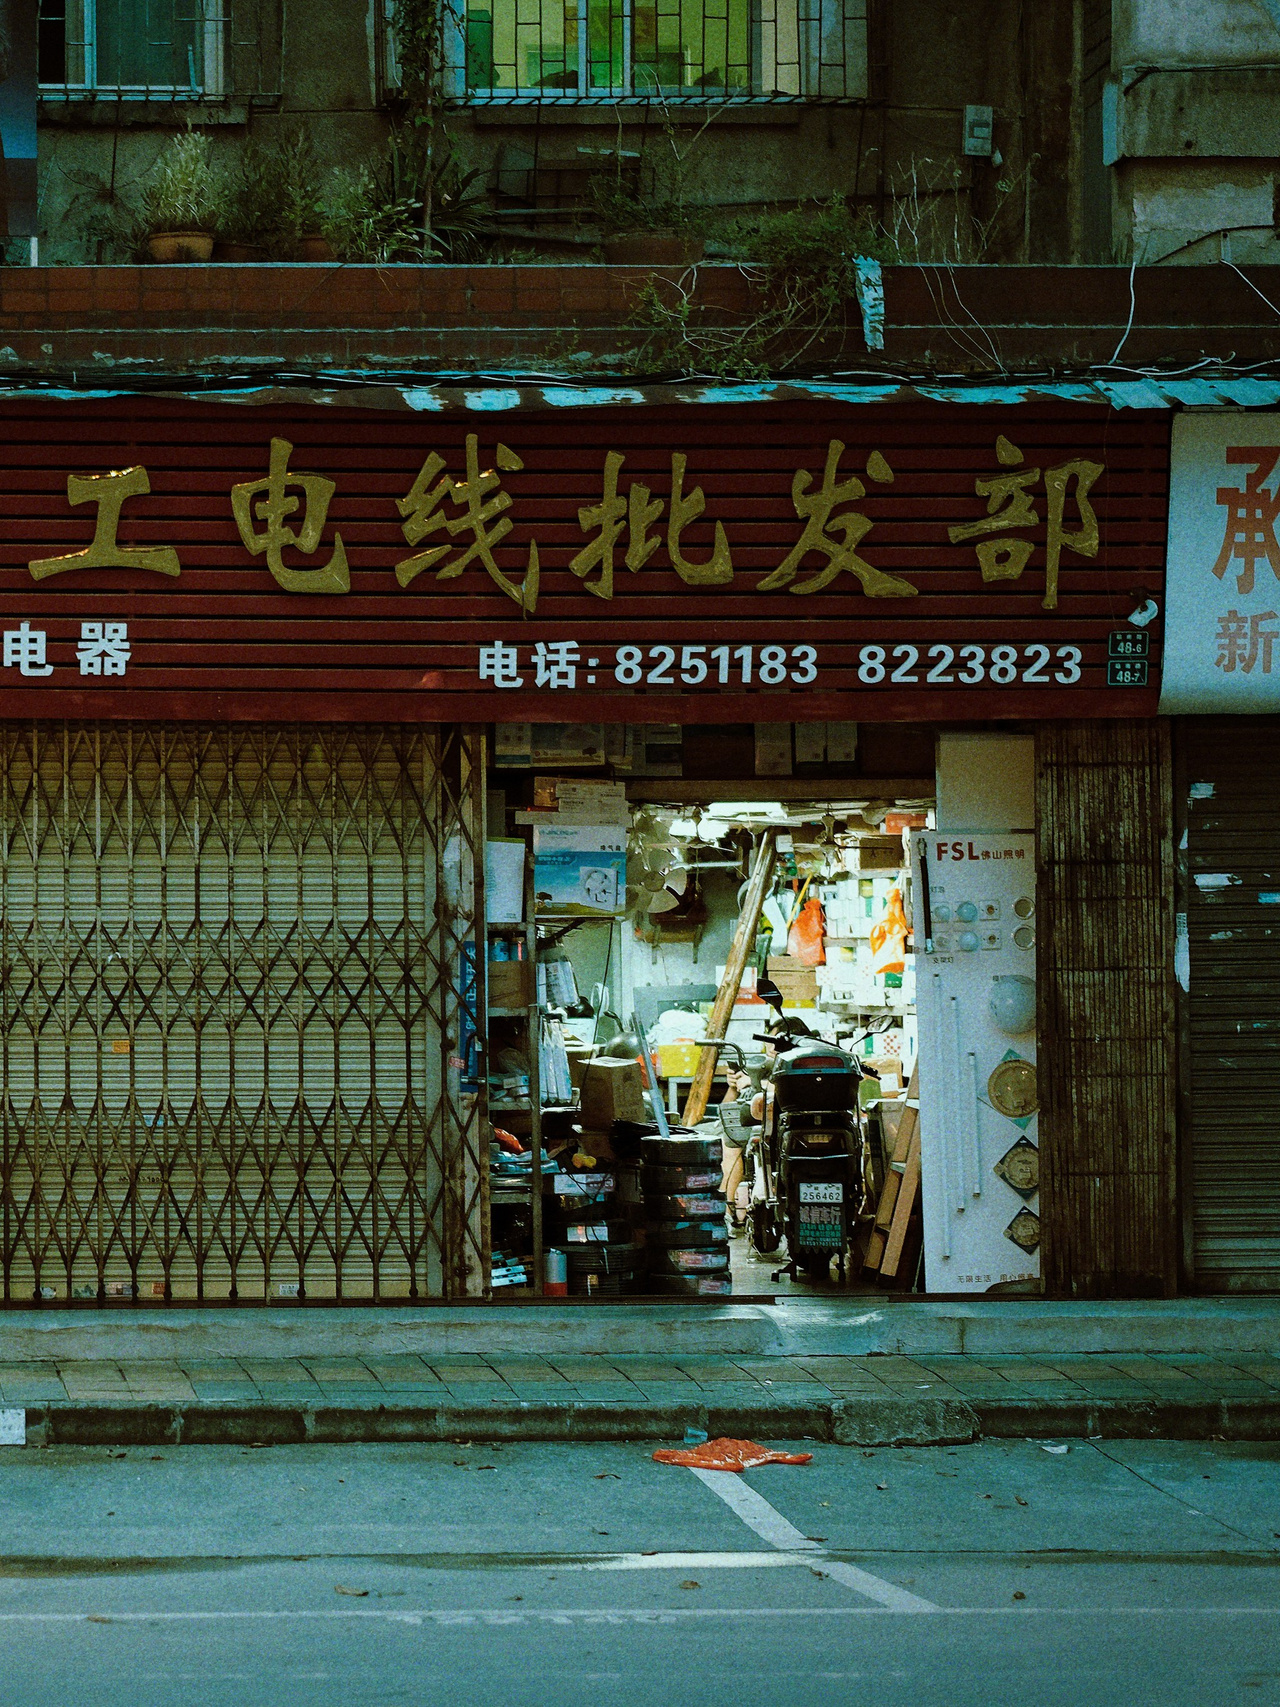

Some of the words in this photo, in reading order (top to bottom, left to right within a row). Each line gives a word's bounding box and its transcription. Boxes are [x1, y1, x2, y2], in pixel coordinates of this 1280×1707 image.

[1117, 642, 1142, 653] 48-6
[1214, 610, 1279, 674] 新
[615, 645, 819, 686] 8251183
[858, 645, 1084, 686] 8223823
[1116, 671, 1140, 682] 48-7
[936, 842, 979, 861] FSL
[981, 849, 1025, 860] 佛山照明
[803, 1192, 841, 1200] 256462
